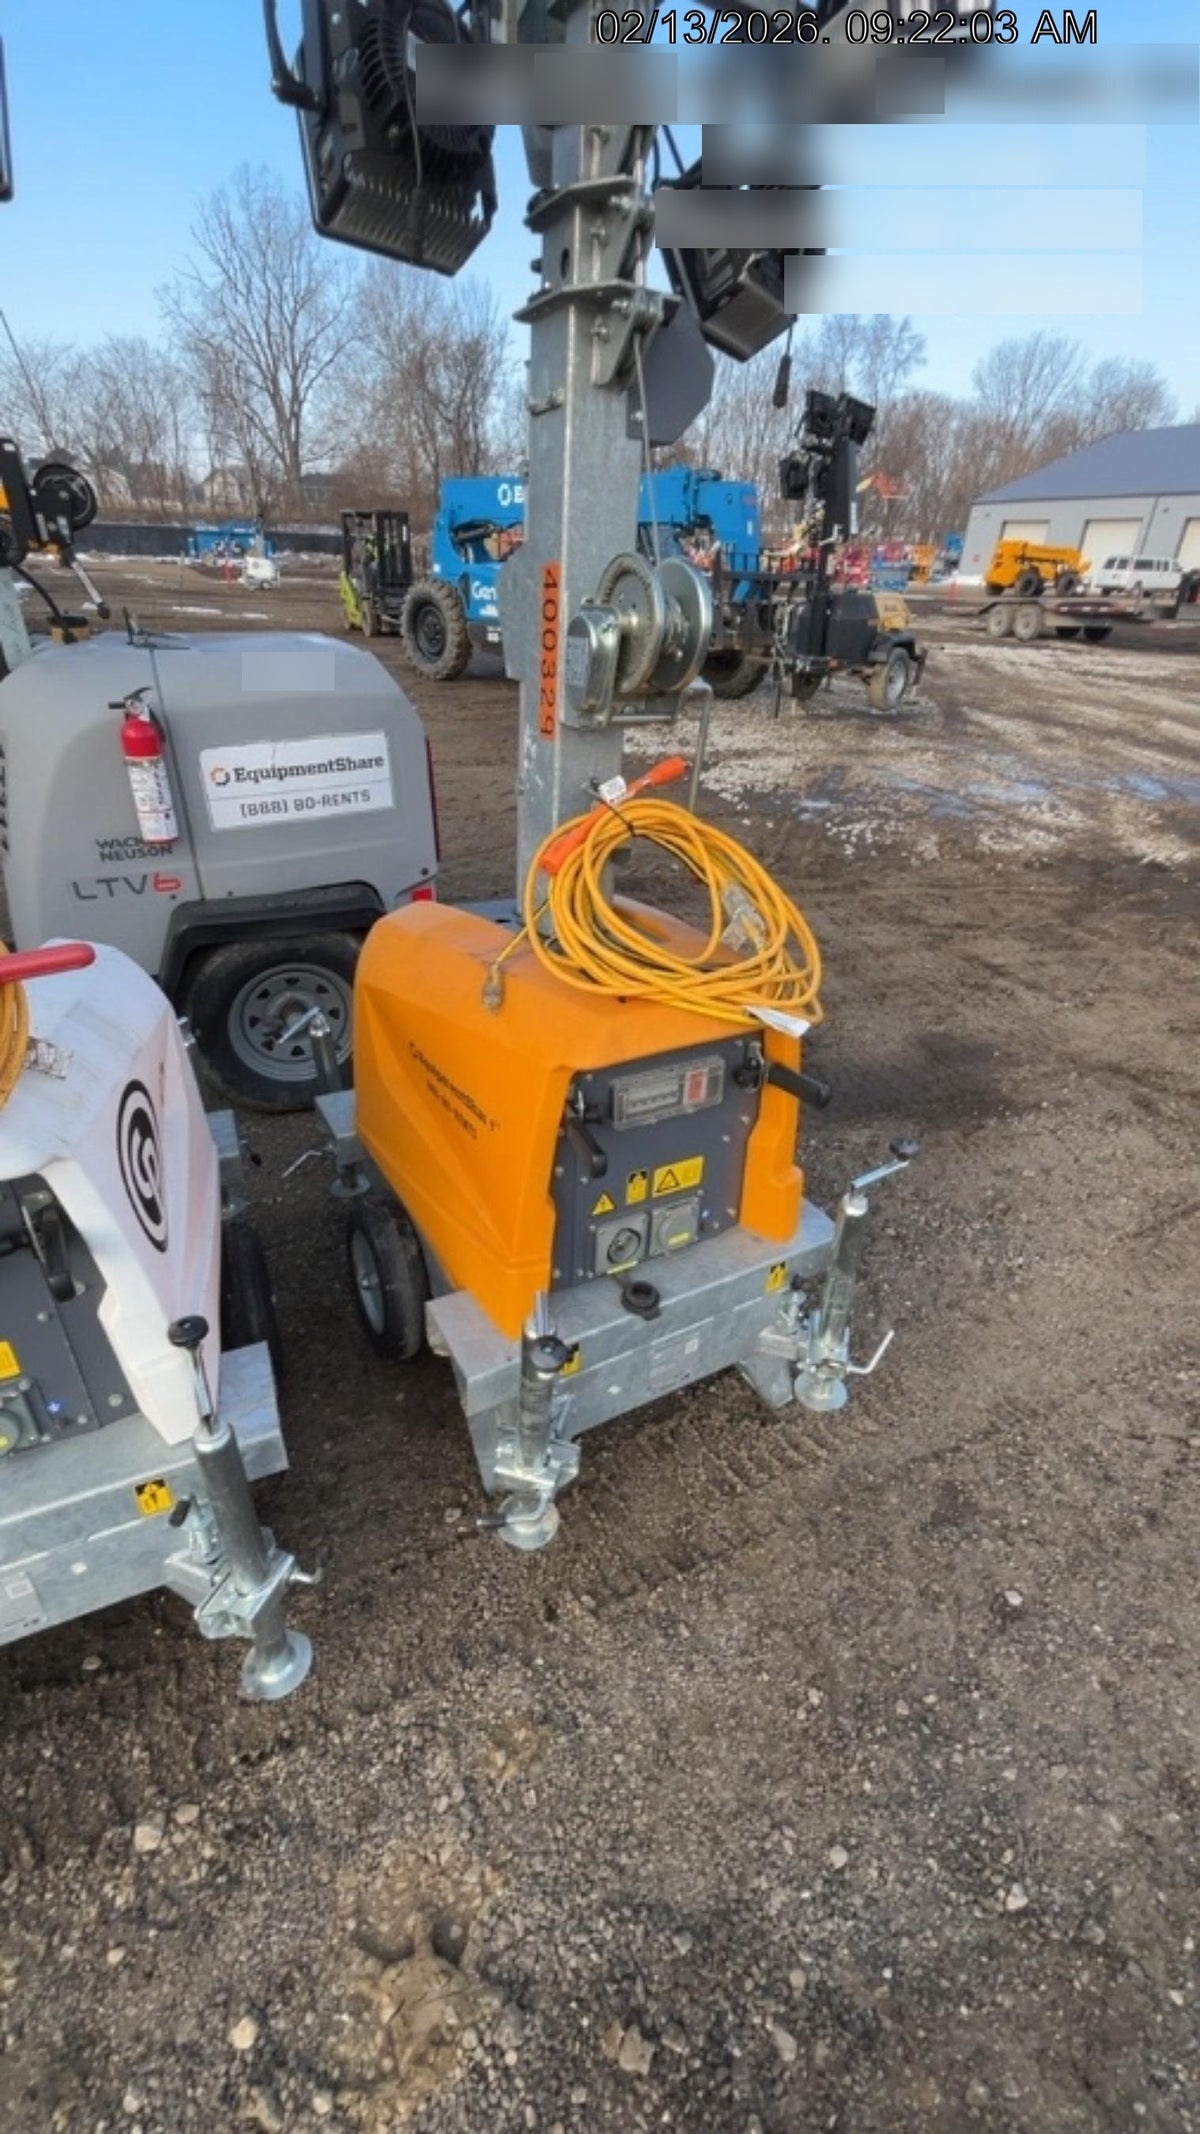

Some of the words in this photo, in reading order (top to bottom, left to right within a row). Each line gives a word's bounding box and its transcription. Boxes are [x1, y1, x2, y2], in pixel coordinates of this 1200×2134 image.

[471, 581, 497, 600] Gen
[540, 568, 558, 735] 400329
[233, 755, 385, 783] EquipmentShare
[240, 798, 288, 818] (888)
[293, 789, 371, 812] 80-RENTS
[95, 836, 146, 850] WACK
[99, 843, 173, 862] NEUSON
[73, 872, 181, 899] LTV6
